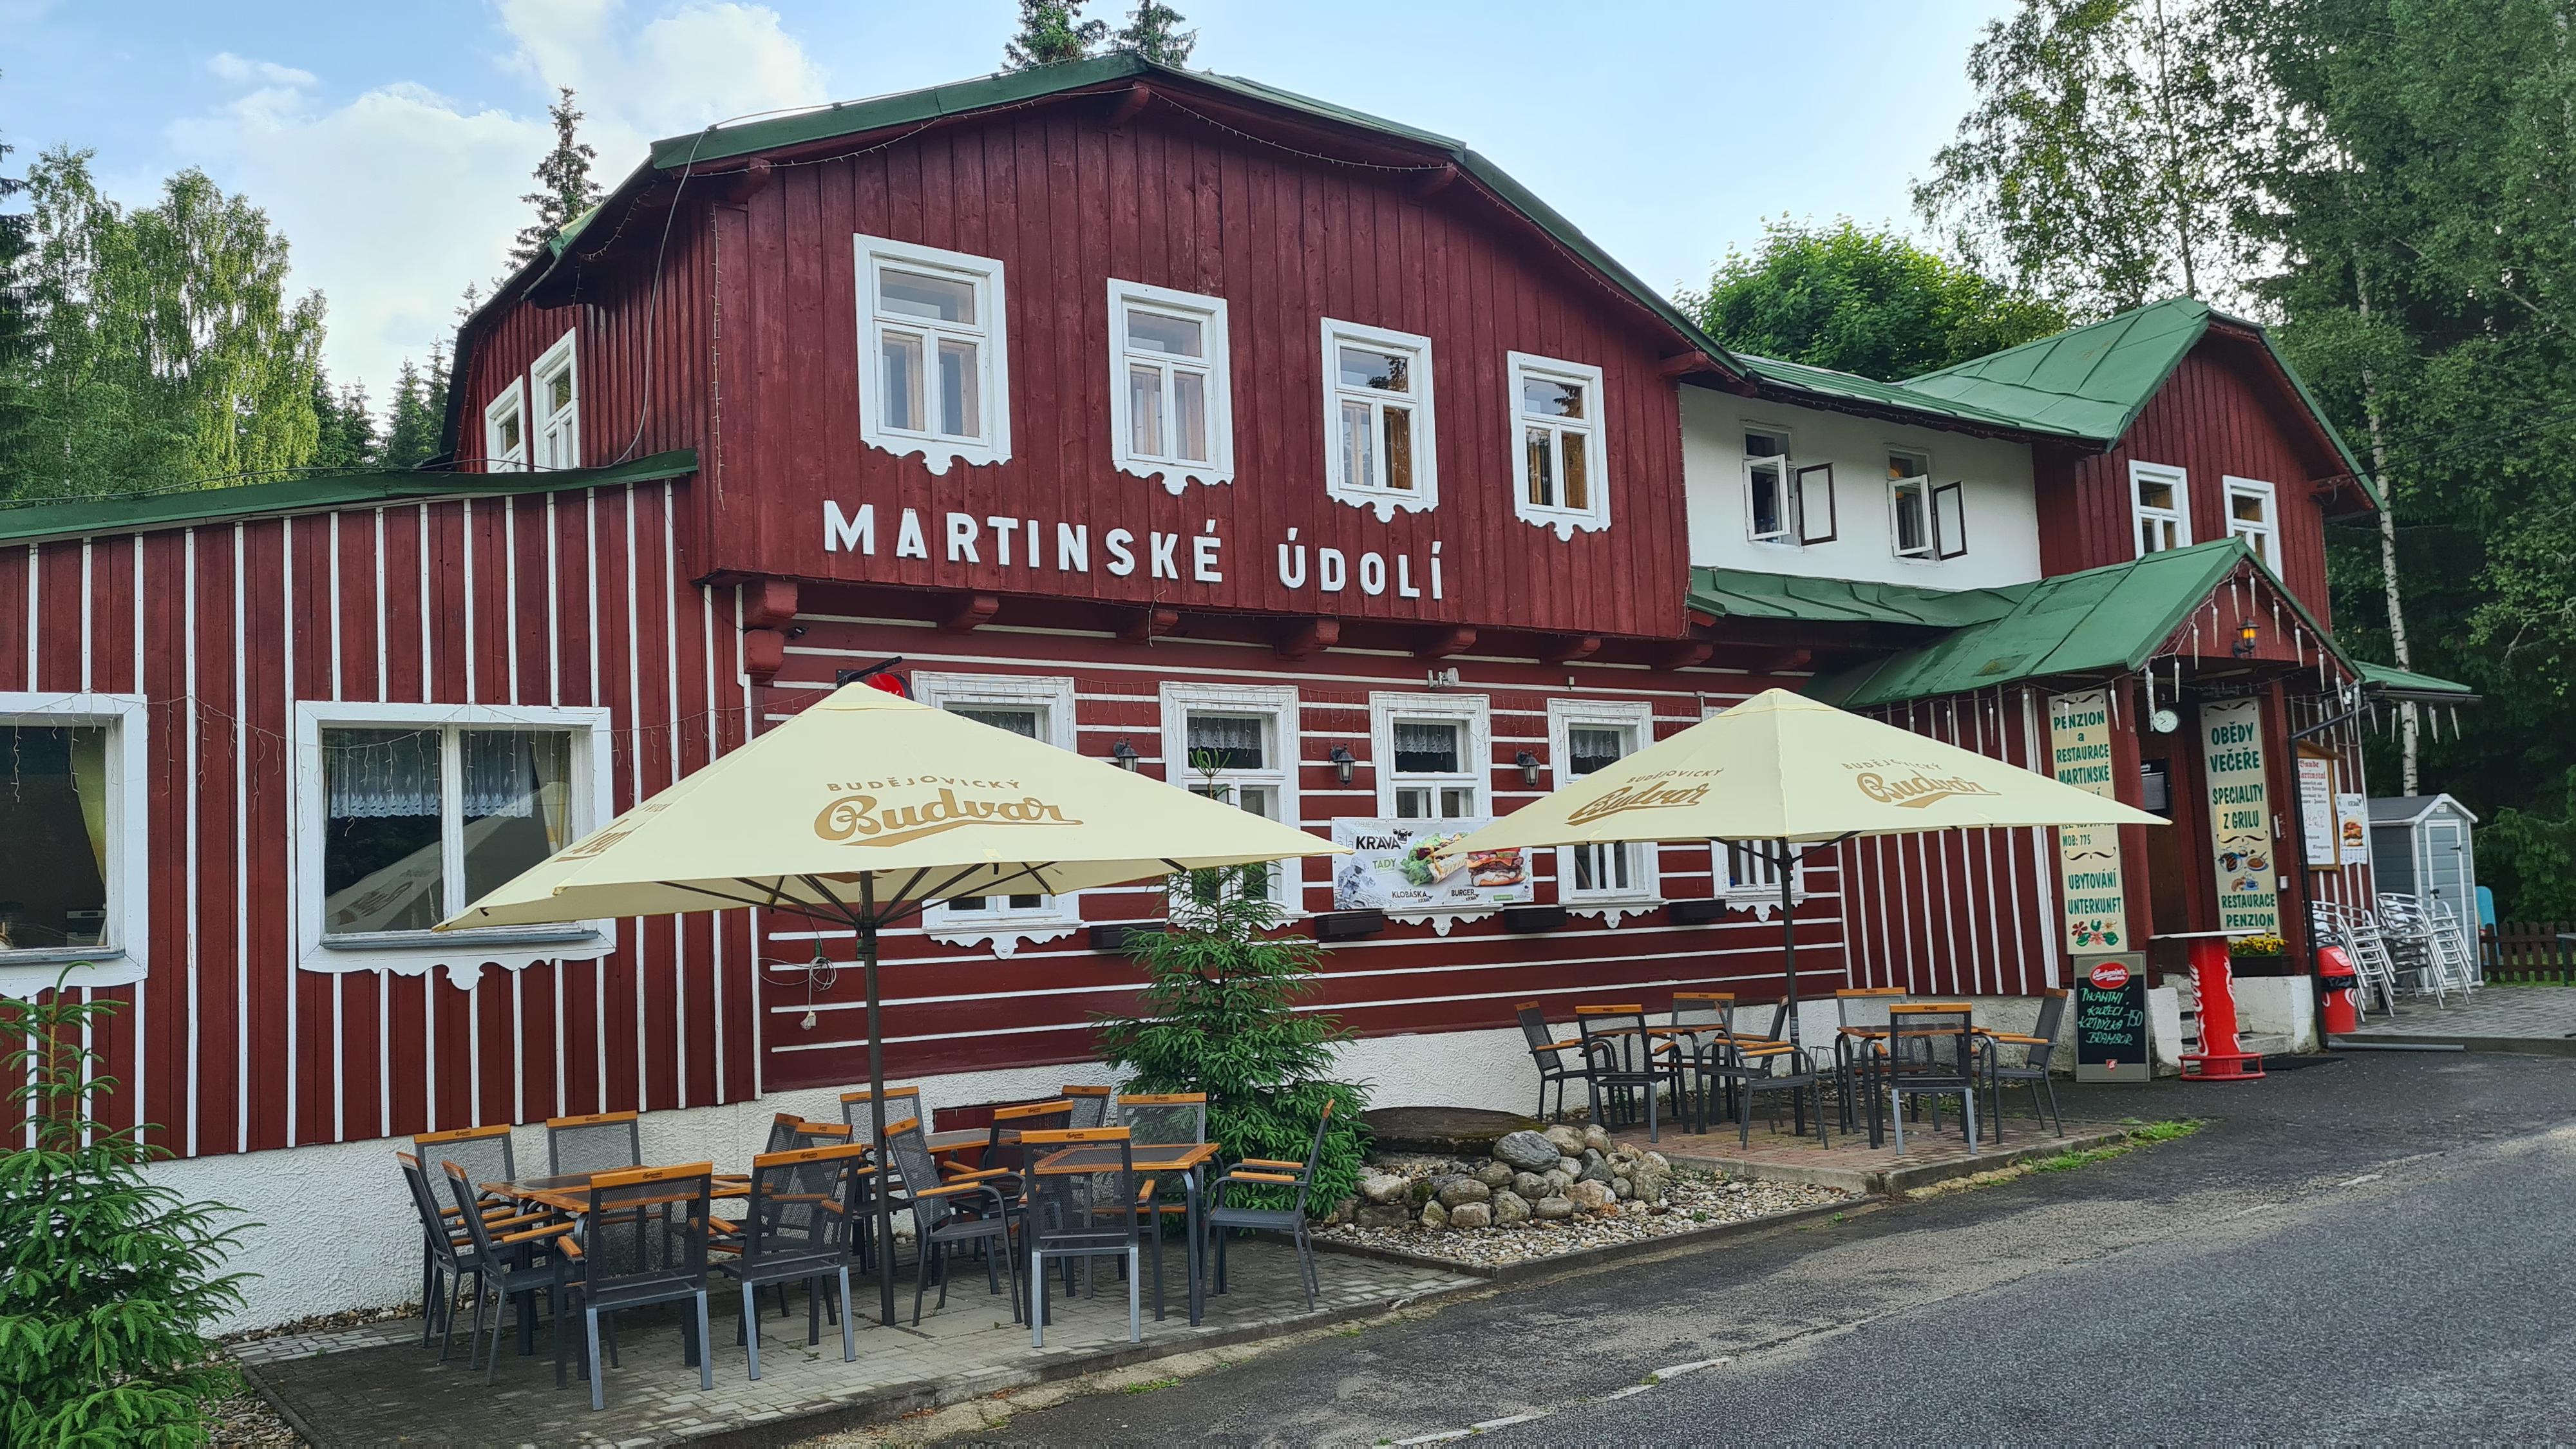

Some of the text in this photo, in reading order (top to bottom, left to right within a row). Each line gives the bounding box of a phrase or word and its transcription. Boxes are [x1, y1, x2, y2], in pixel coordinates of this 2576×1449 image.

[823, 500, 1442, 600] MARTINSKÉ ÚDOLÍ
[2053, 710, 2105, 730] PENZION
[2078, 732, 2085, 742] a
[2211, 721, 2254, 745] OBĚDY
[2056, 744, 2109, 763] RESTAURACE
[2210, 747, 2260, 773] VEČEŘE
[1626, 768, 1725, 783] BUDĚJOVICKÝ
[2058, 761, 2110, 785] MARTINSKÉ
[827, 775, 1022, 792] BUDĚJOVICKÝ
[1856, 769, 2002, 809] Budvar
[2212, 782, 2264, 805] SPECIALITY
[1564, 781, 1711, 826] Budvar
[814, 788, 1084, 848] Budvar
[2223, 810, 2259, 829] Z GRILU
[2062, 834, 2091, 847] MOB: 775
[1372, 858, 1397, 869] TADY
[2068, 867, 2117, 890] UBYTOVÁNÍ
[1451, 889, 1475, 897] BURGER
[2221, 893, 2275, 908] RESTAURACE
[2067, 897, 2121, 914] UNTERKUNFT
[2226, 913, 2275, 927] PENZION
